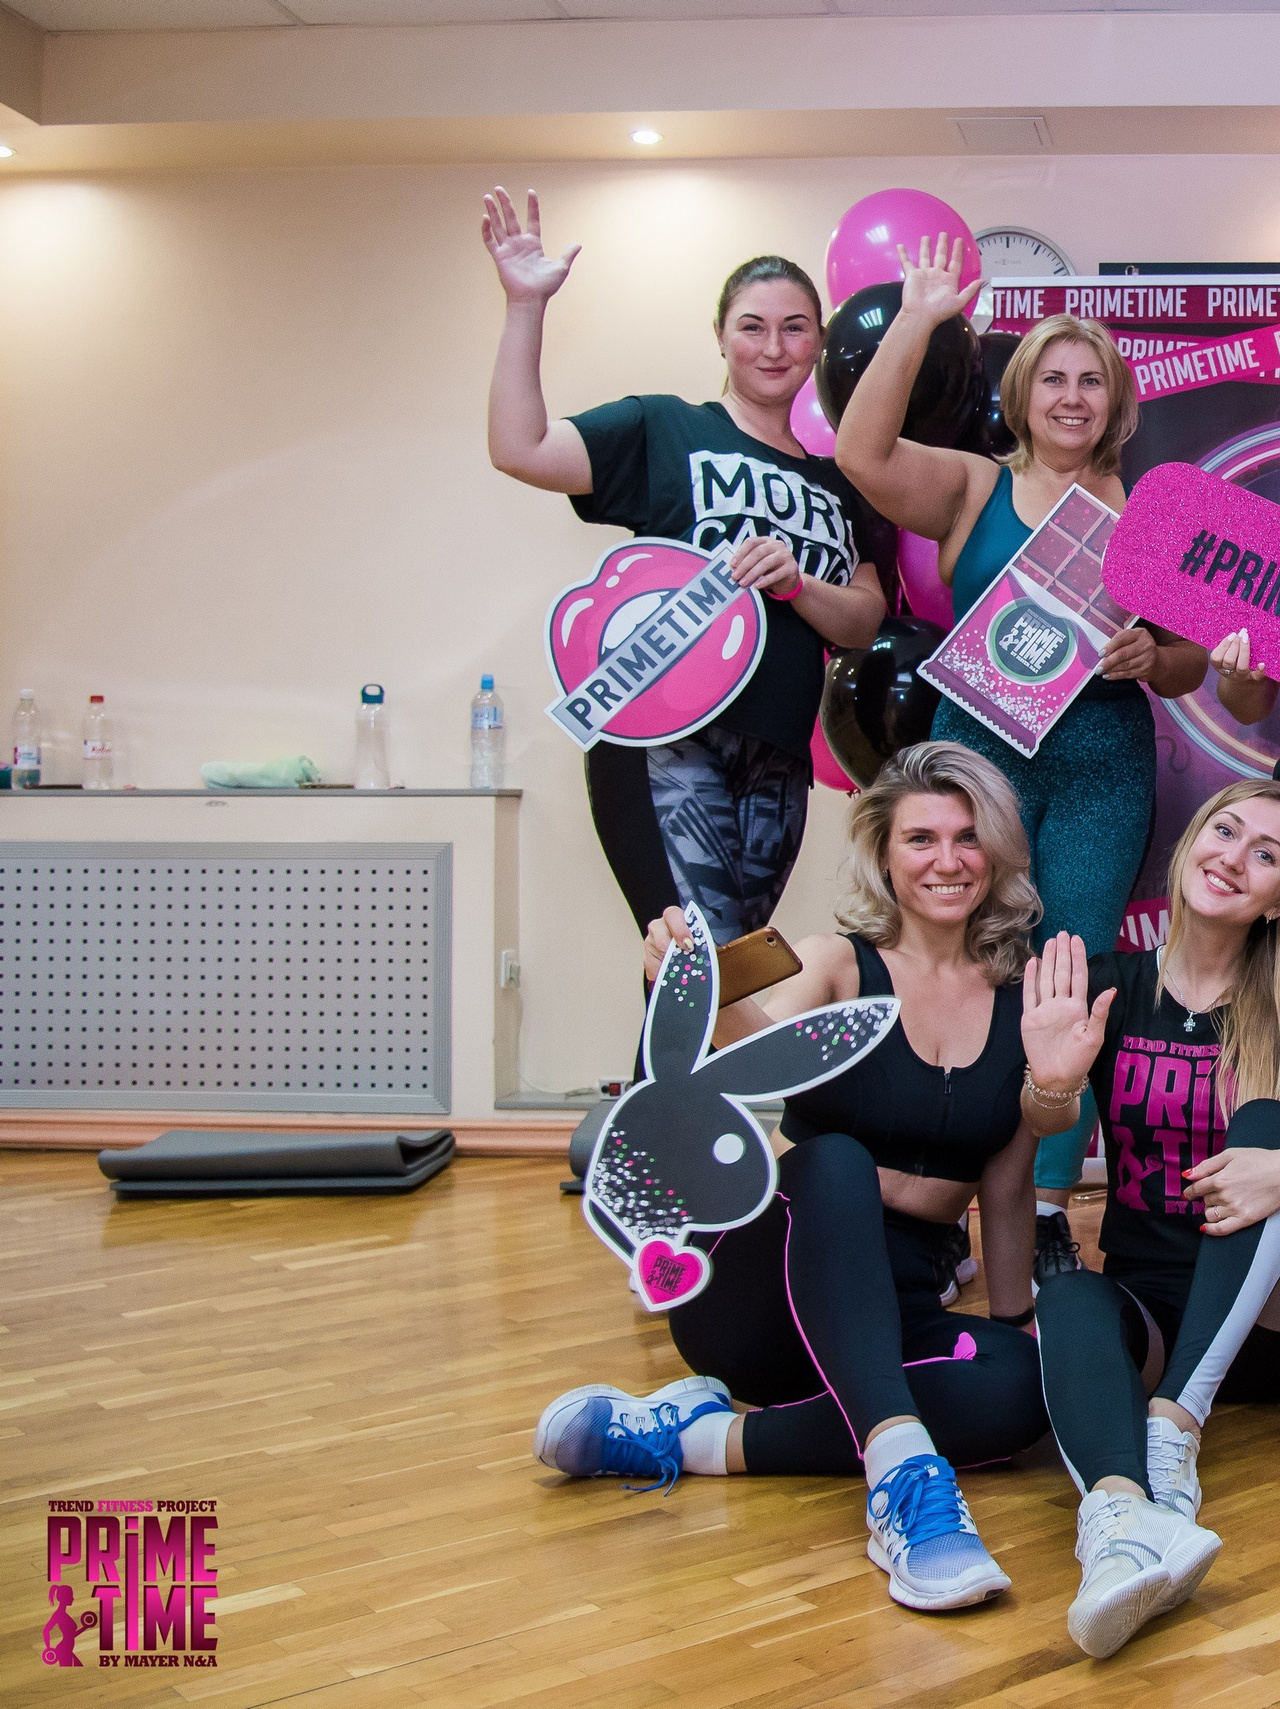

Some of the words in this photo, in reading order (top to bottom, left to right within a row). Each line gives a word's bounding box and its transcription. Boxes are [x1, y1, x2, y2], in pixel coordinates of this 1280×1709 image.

[993, 289, 1045, 319] TIME
[1065, 288, 1187, 318] PRIMETIME
[1134, 338, 1260, 395] PRIMETIME
[565, 559, 742, 731] PRIMETIME
[1123, 1035, 1167, 1053] TREND
